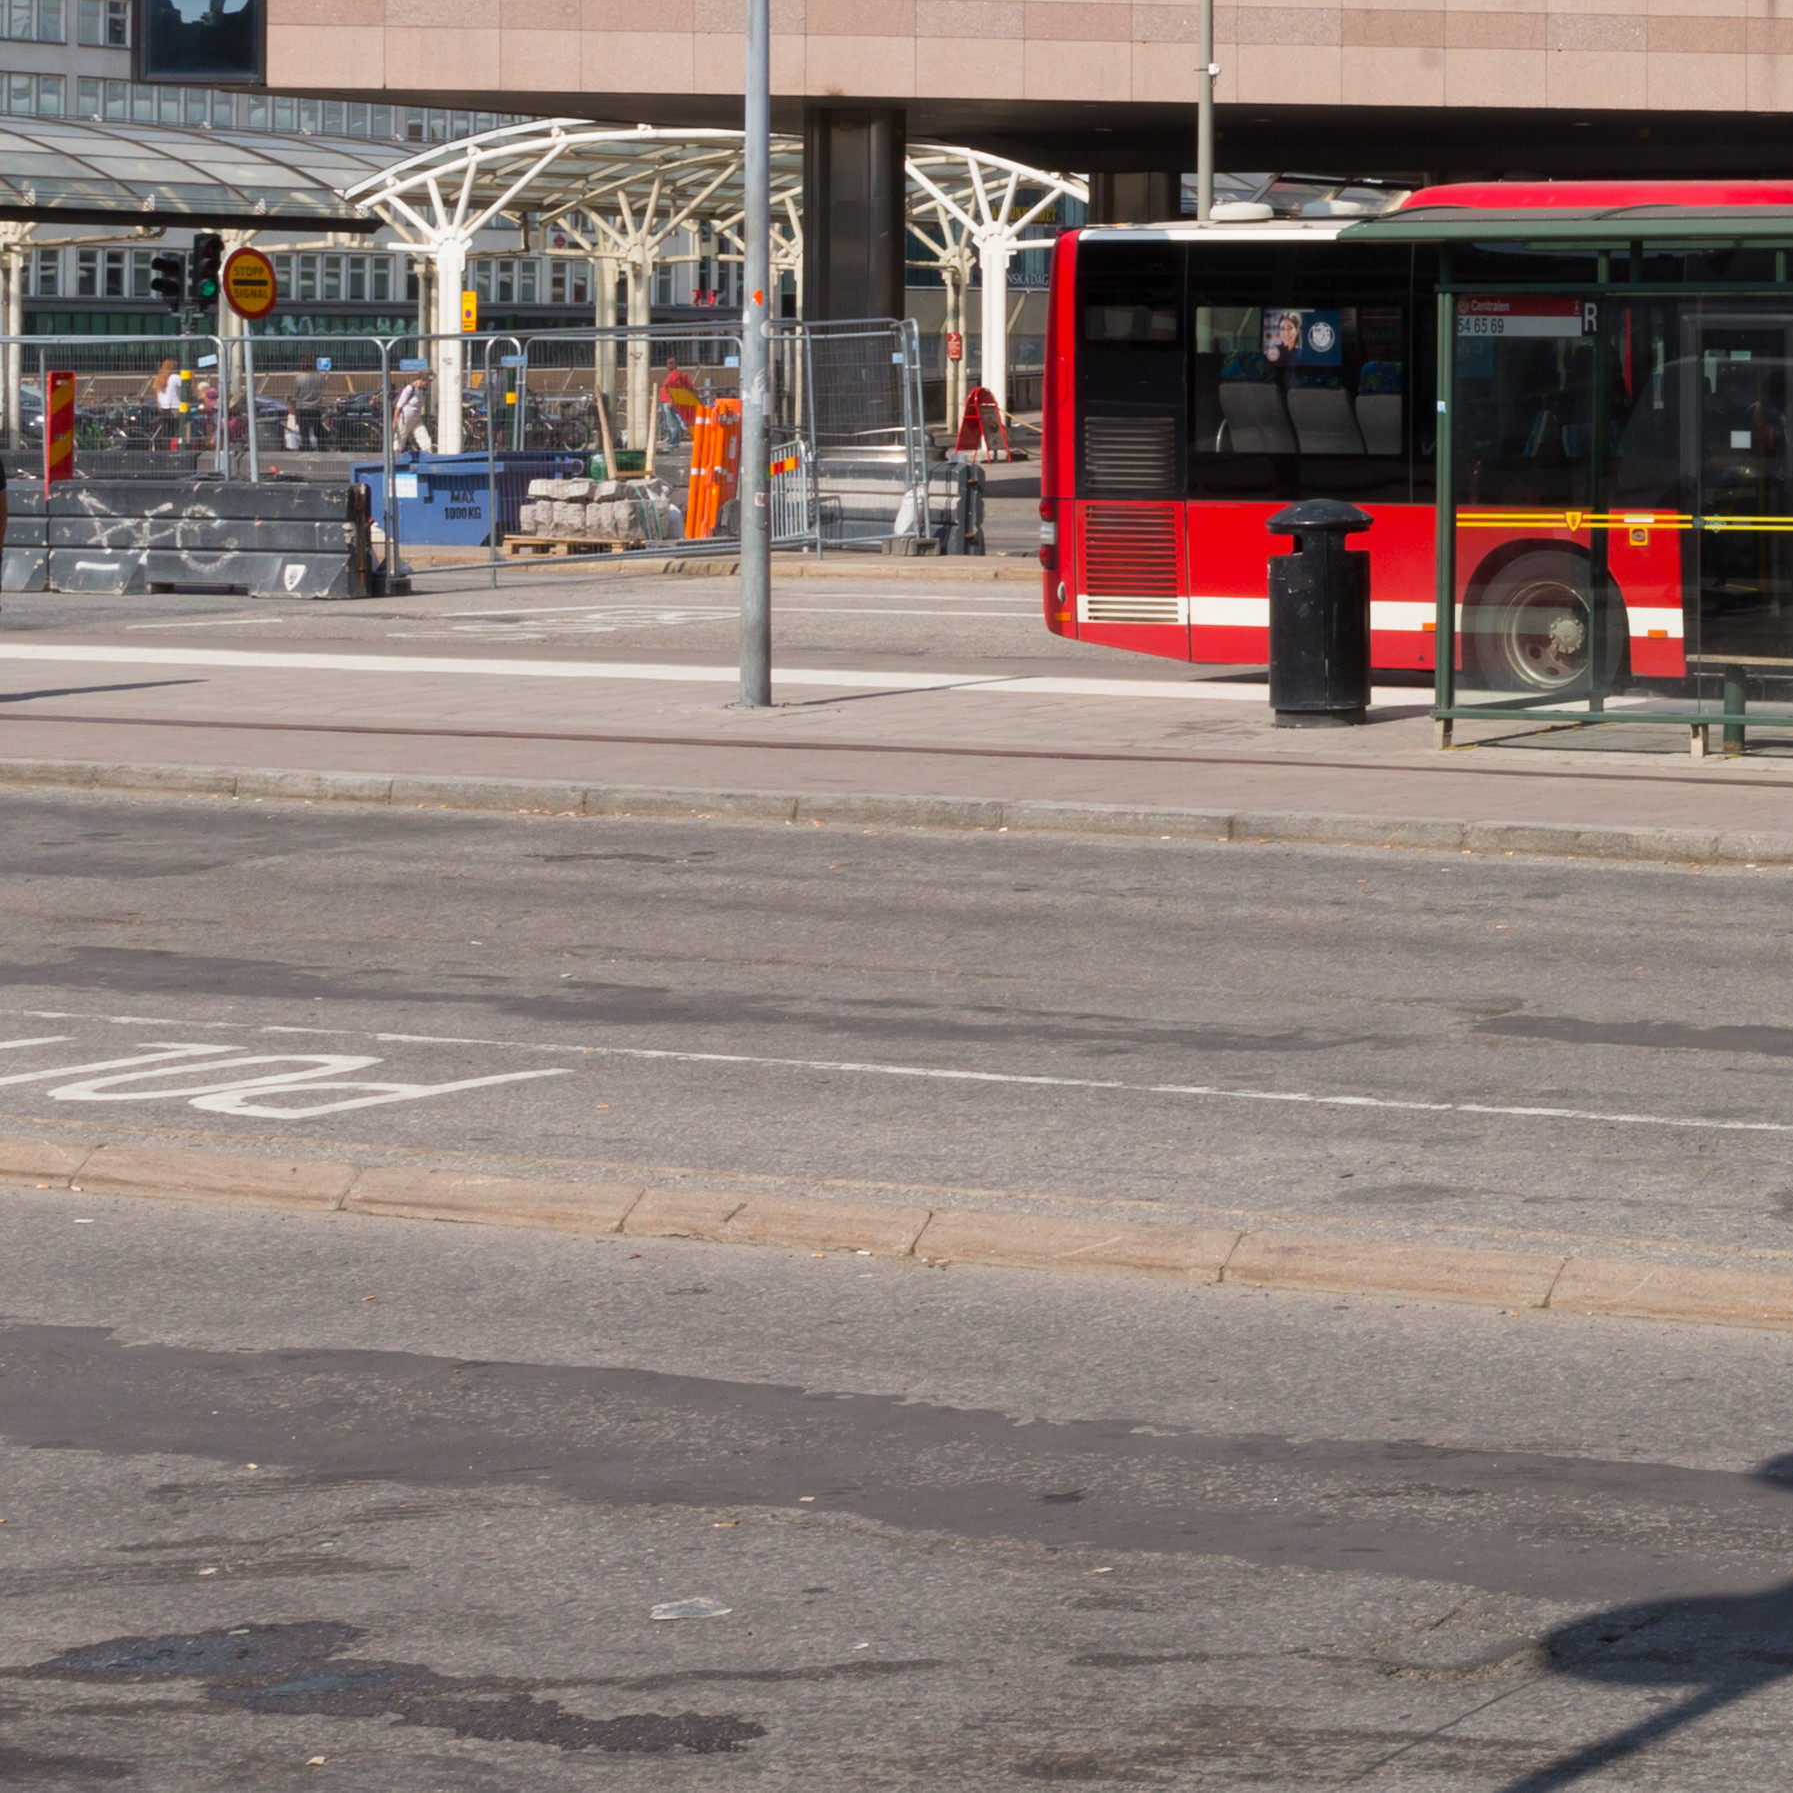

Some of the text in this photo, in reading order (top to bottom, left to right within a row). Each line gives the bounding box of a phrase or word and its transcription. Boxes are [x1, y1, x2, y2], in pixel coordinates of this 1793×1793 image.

[234, 266, 264, 277] STOPP
[234, 288, 269, 299] SIGNAL
[1471, 300, 1510, 312] Centralen
[1584, 302, 1598, 332] R
[1458, 318, 1504, 333] 54 65 69
[450, 489, 476, 503] MAX
[444, 507, 482, 520] 1000 KG
